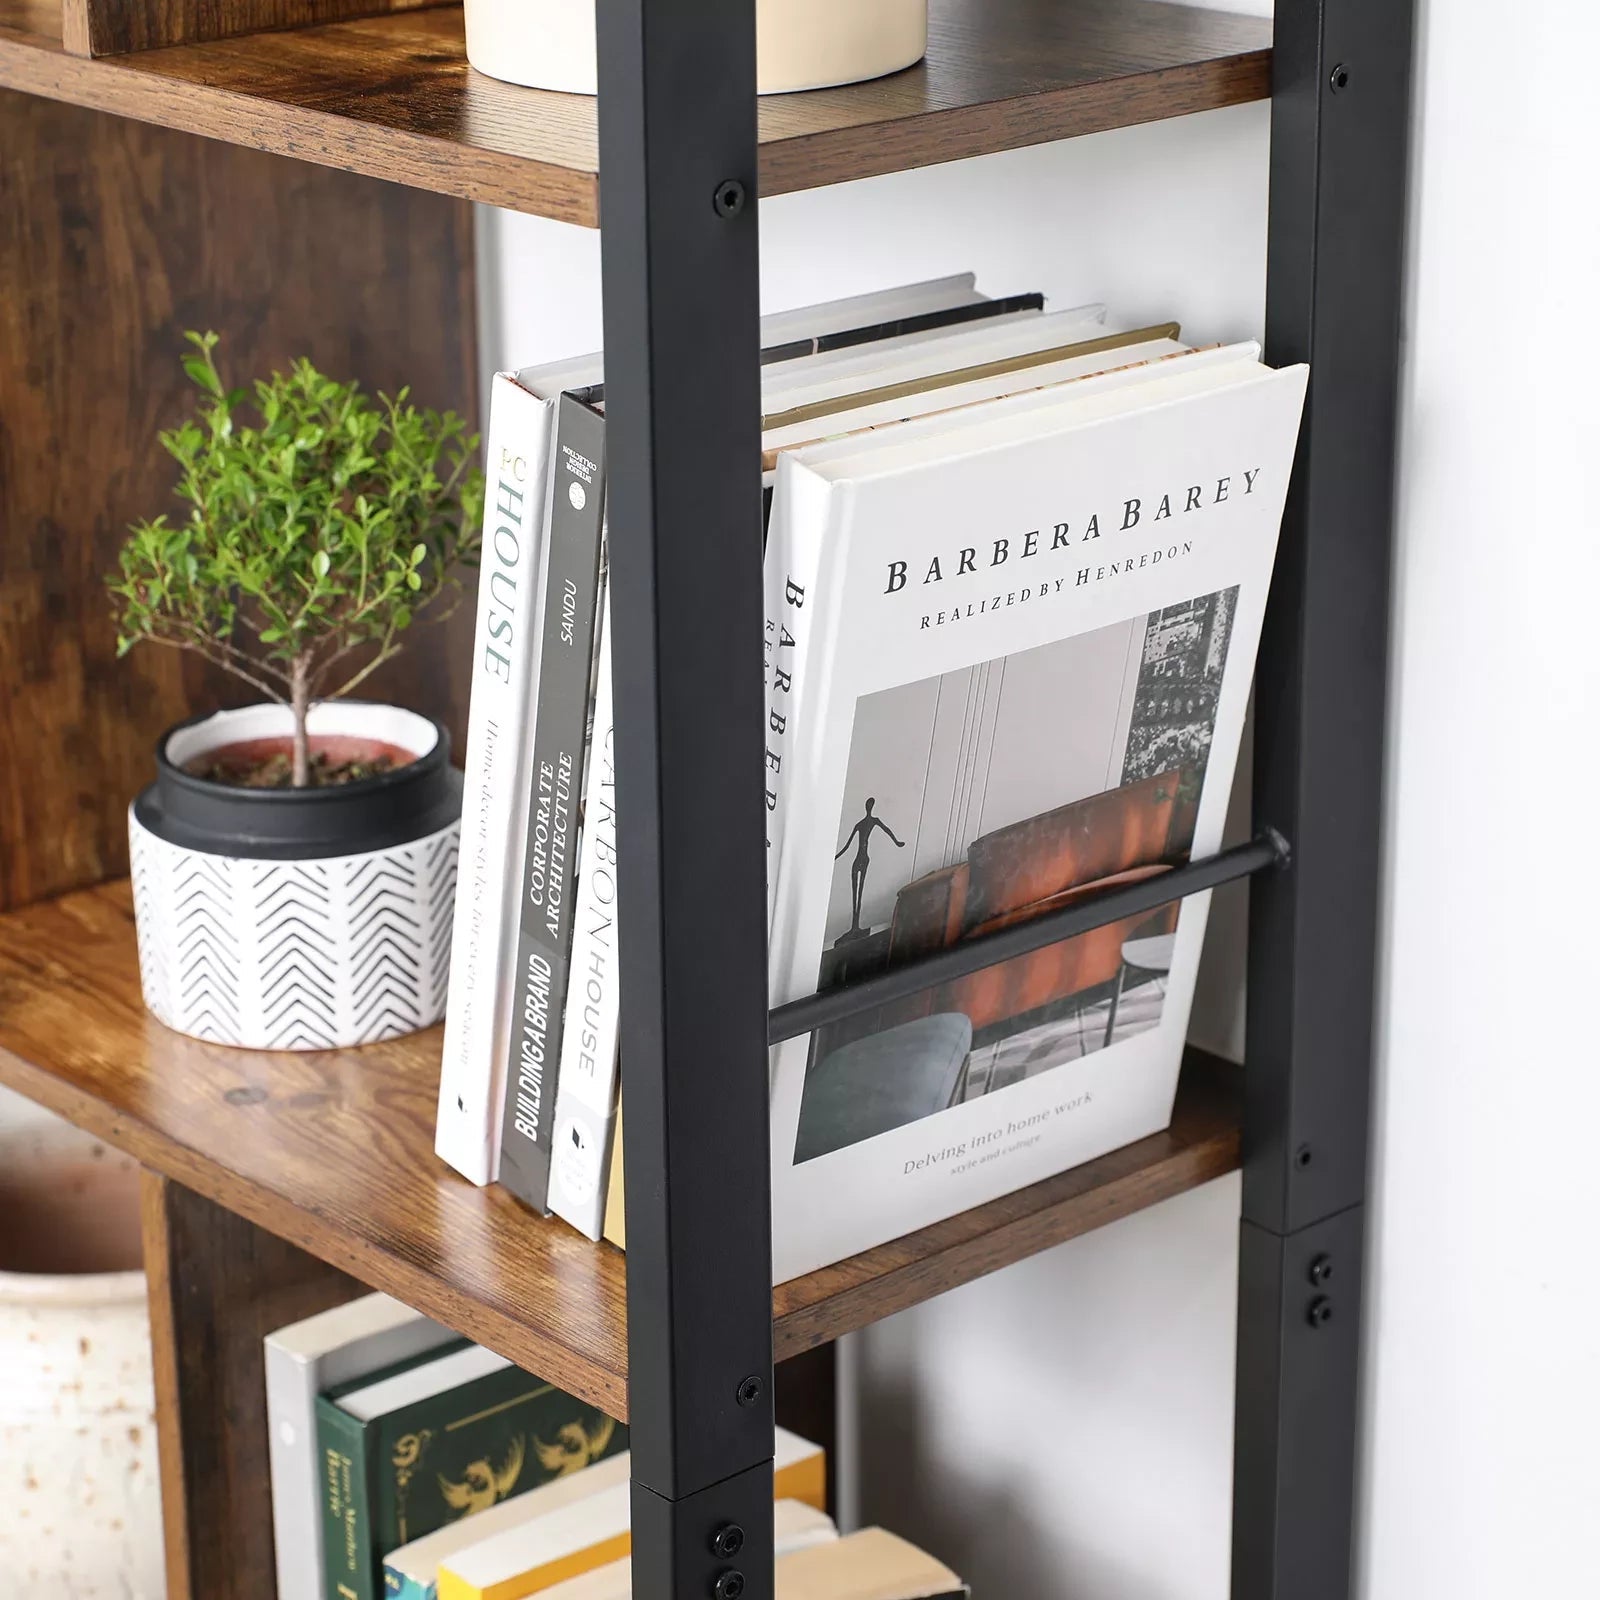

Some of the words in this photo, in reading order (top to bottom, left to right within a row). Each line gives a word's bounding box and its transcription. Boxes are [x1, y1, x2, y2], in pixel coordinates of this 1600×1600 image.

[562, 445, 597, 472] COLLECTION
[484, 479, 524, 685] HOUSE
[883, 514, 1101, 594] BARBERA
[1119, 467, 1262, 532] BAREY
[919, 587, 1031, 630] REALIZED
[1039, 578, 1065, 598] BY
[1075, 540, 1194, 587] HENREDON
[560, 578, 577, 646] SANDU
[529, 761, 553, 906] CORPORATE
[545, 751, 573, 939] ARCHITECTURE
[579, 951, 605, 1078] HOUSE
[903, 1141, 967, 1175] Delving
[970, 1128, 1003, 1149] into
[1006, 1109, 1051, 1135] home
[1054, 1091, 1094, 1115] work
